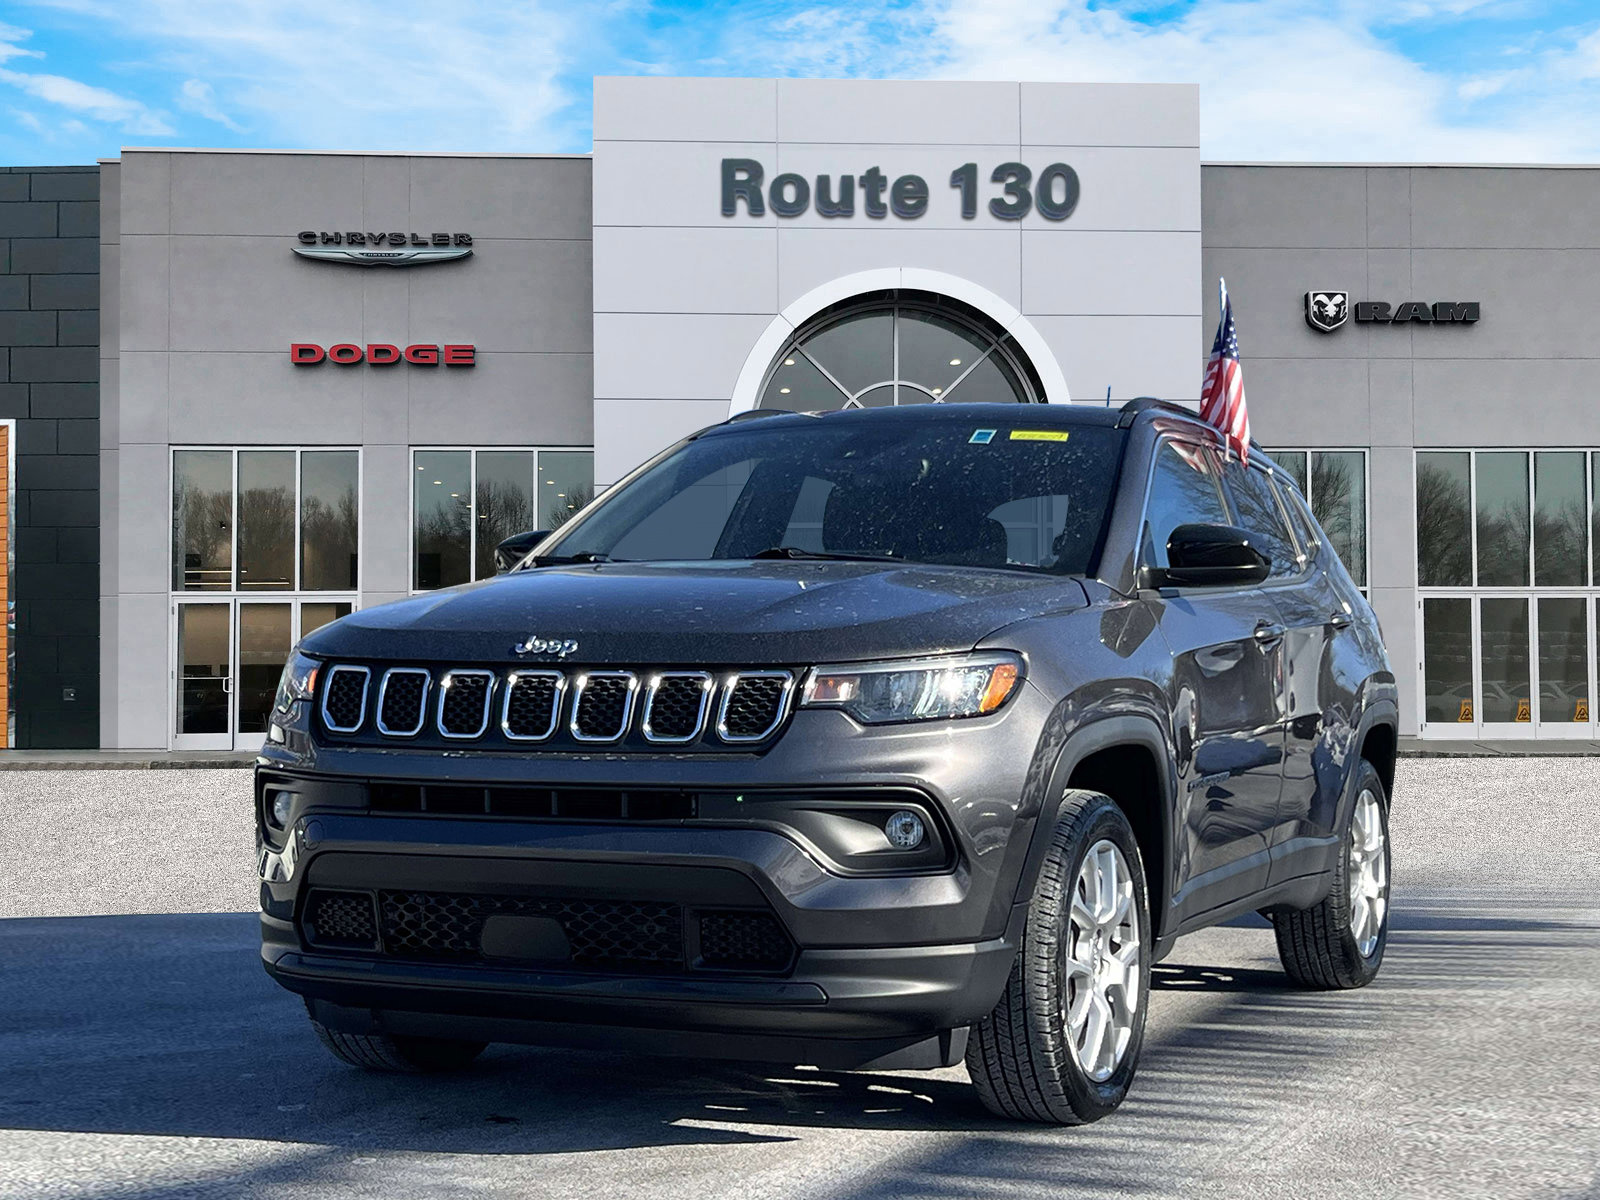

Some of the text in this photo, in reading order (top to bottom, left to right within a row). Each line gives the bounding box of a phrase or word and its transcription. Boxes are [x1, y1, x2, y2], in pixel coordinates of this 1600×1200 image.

[721, 158, 1080, 220] Route 130
[298, 231, 472, 246] CHRYSLER
[1354, 301, 1480, 324] RAM
[290, 343, 475, 365] DODGE
[515, 635, 578, 657] Jeep
